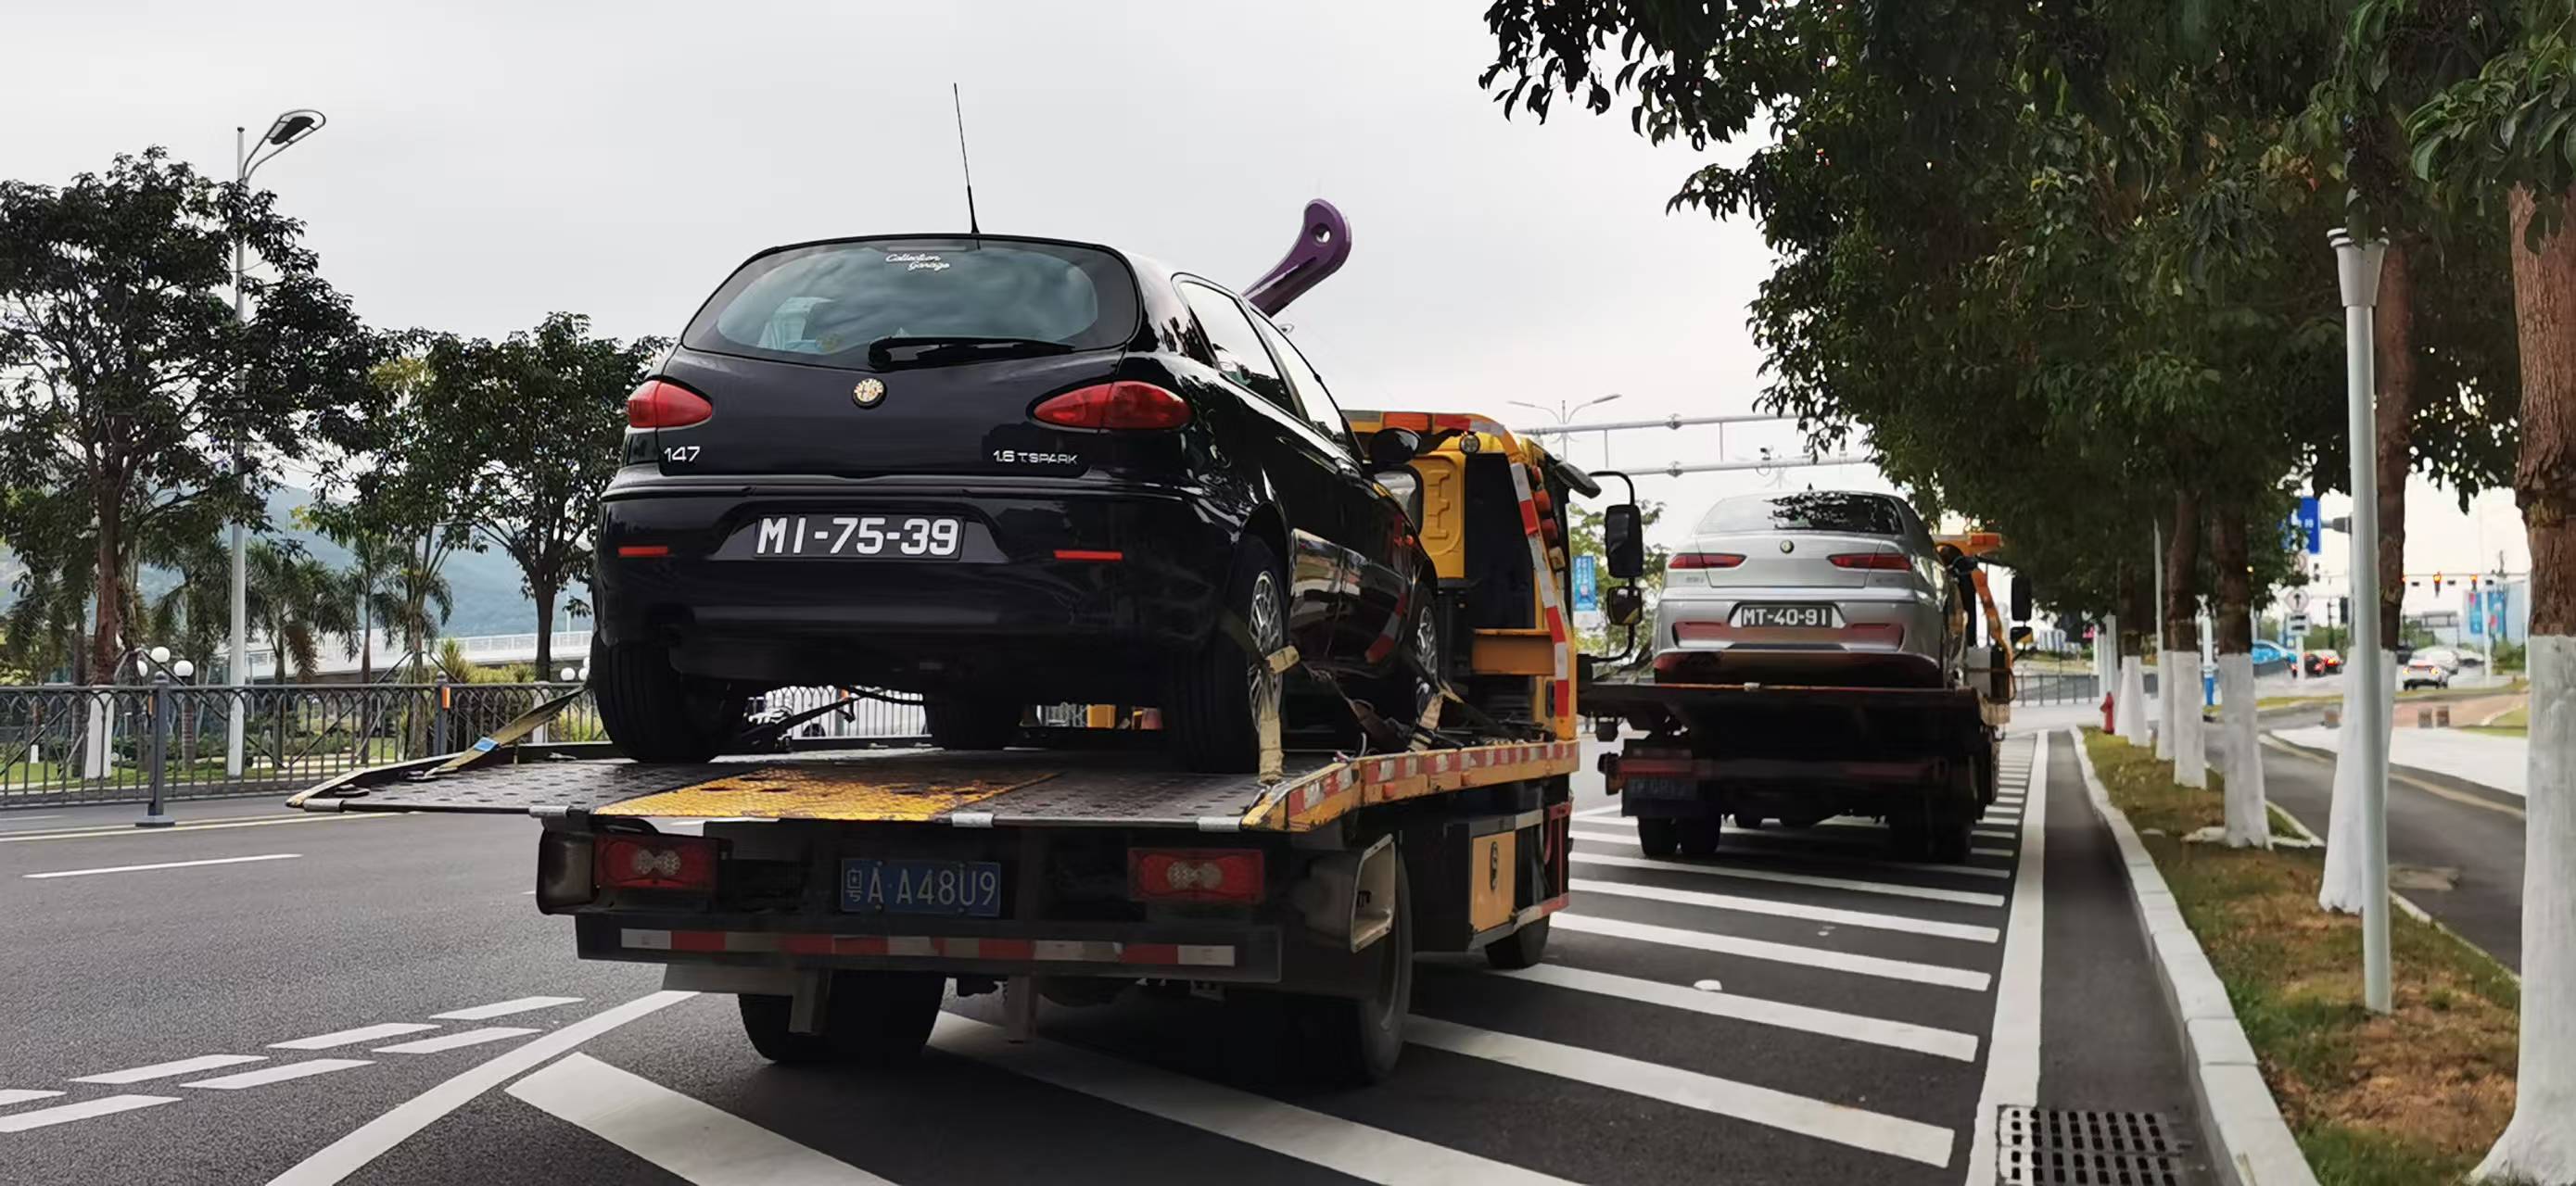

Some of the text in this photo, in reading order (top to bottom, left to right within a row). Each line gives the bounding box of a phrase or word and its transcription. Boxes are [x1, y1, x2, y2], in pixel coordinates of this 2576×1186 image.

[664, 446, 700, 462] 147
[756, 516, 959, 556] MI-75-39
[1744, 609, 1826, 625] MT-40-91
